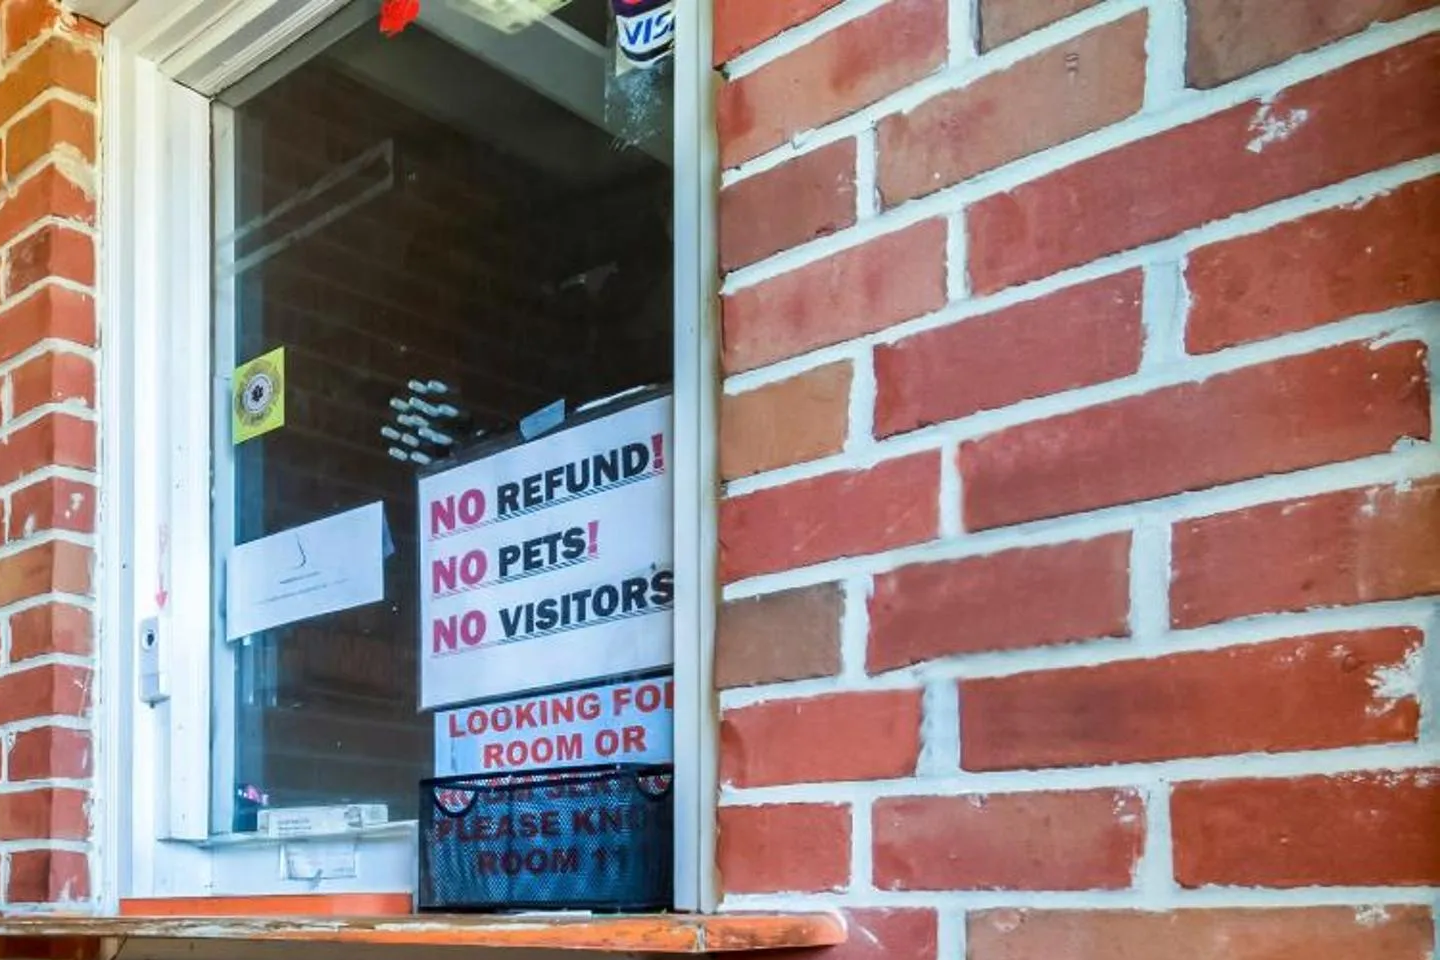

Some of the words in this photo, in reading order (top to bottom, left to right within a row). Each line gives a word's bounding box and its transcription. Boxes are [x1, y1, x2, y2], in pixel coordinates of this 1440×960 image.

[430, 488, 486, 534] NO
[497, 433, 664, 515] REFUND!
[432, 550, 487, 594] NO
[498, 520, 599, 577] PETS!
[432, 610, 487, 653] NO
[498, 570, 674, 638] VISITORS
[448, 692, 601, 738] LOOKING
[482, 734, 583, 768] ROOM
[594, 725, 647, 757] OR
